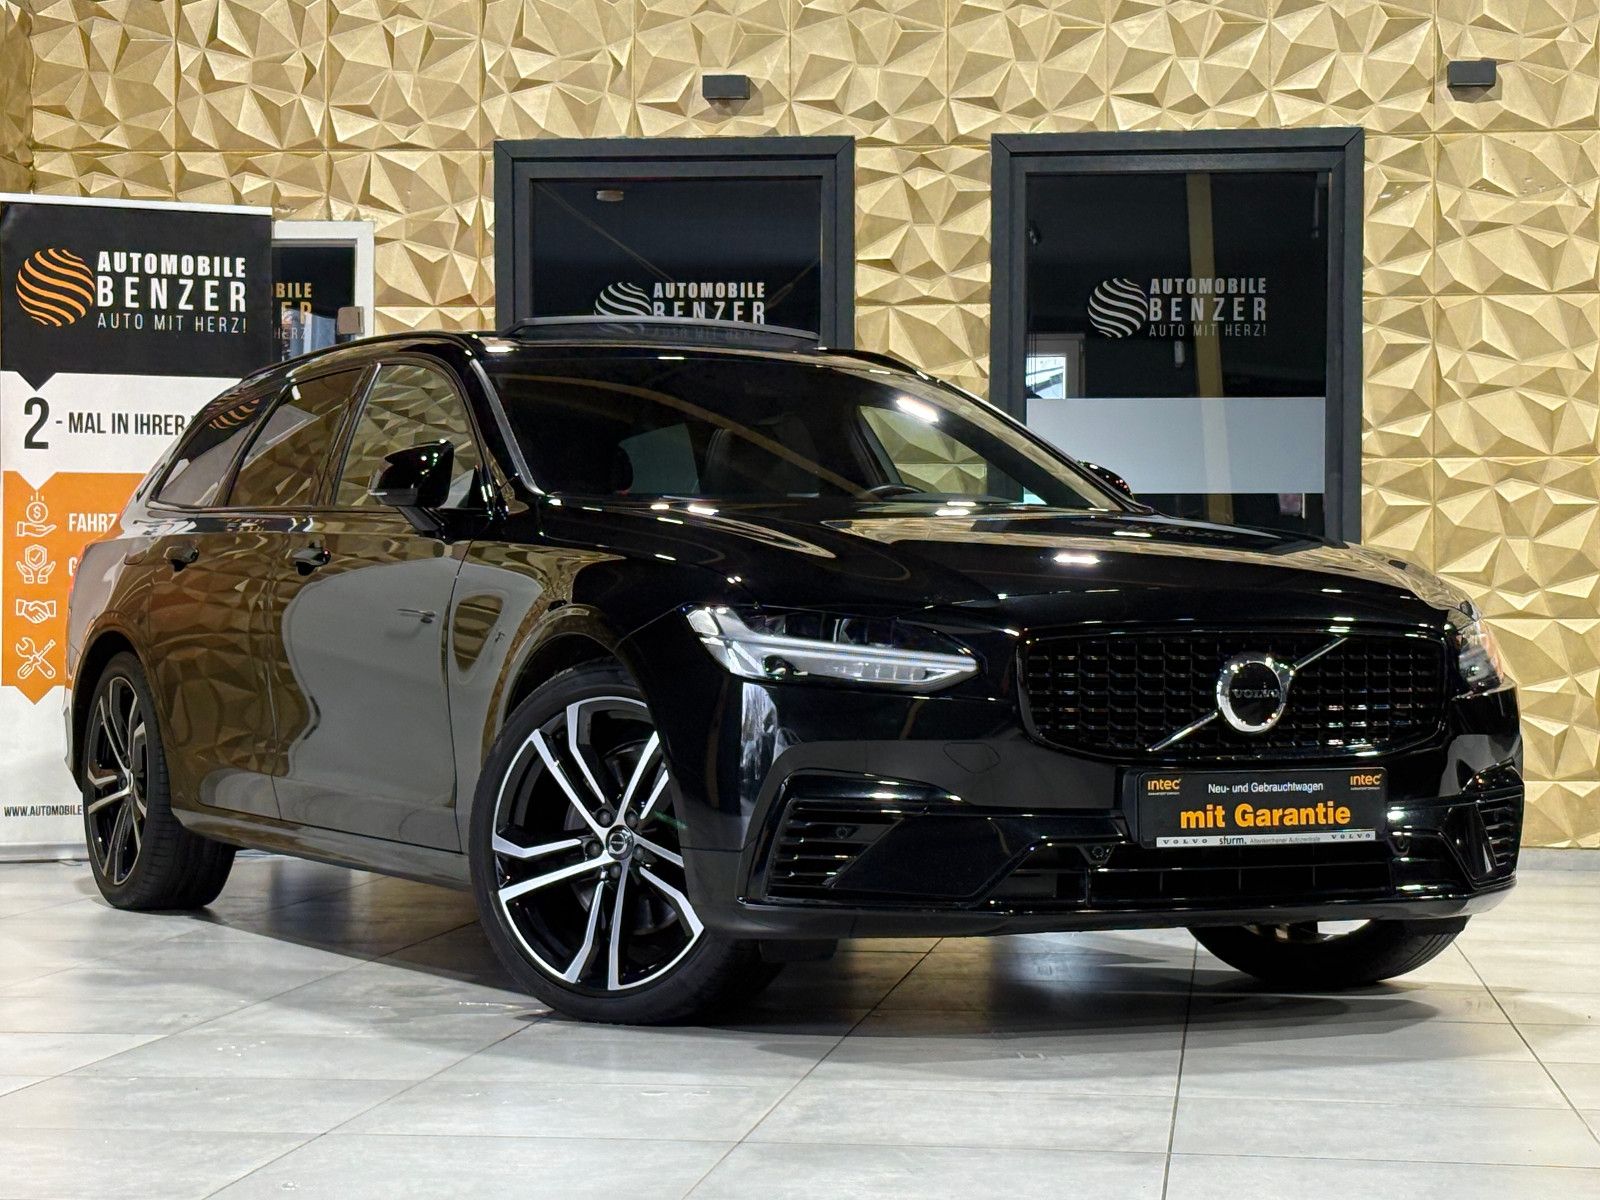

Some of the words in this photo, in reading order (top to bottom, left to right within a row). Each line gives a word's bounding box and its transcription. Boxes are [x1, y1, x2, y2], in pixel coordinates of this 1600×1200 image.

[97, 251, 246, 278] AUTOMOBILE
[97, 275, 246, 312] BENZER
[653, 282, 765, 298] AUTOMOBILE
[1150, 278, 1267, 294] AUTOMOBILE
[1149, 297, 1267, 322] BENZER
[98, 312, 144, 330] AUTO
[154, 314, 184, 332] MIT
[195, 316, 247, 334] HERZ!
[1149, 324, 1185, 337] AUTO
[1193, 324, 1219, 337] MIT
[1225, 323, 1267, 337] HERZ!
[24, 396, 50, 450] 2
[68, 412, 107, 434] MAL
[112, 412, 129, 435] IN
[134, 413, 186, 436] IHRER
[1232, 688, 1281, 699] VOLVO
[1147, 778, 1181, 791] intec
[1208, 783, 1230, 794] Neu-
[1232, 782, 1249, 793] und
[1251, 781, 1324, 794] Gebrauchtwagen
[1350, 774, 1382, 786] intec
[4, 804, 82, 817] WWW.AUTOMOBILE
[1180, 804, 1226, 829] mit
[1234, 801, 1351, 828] Garantie
